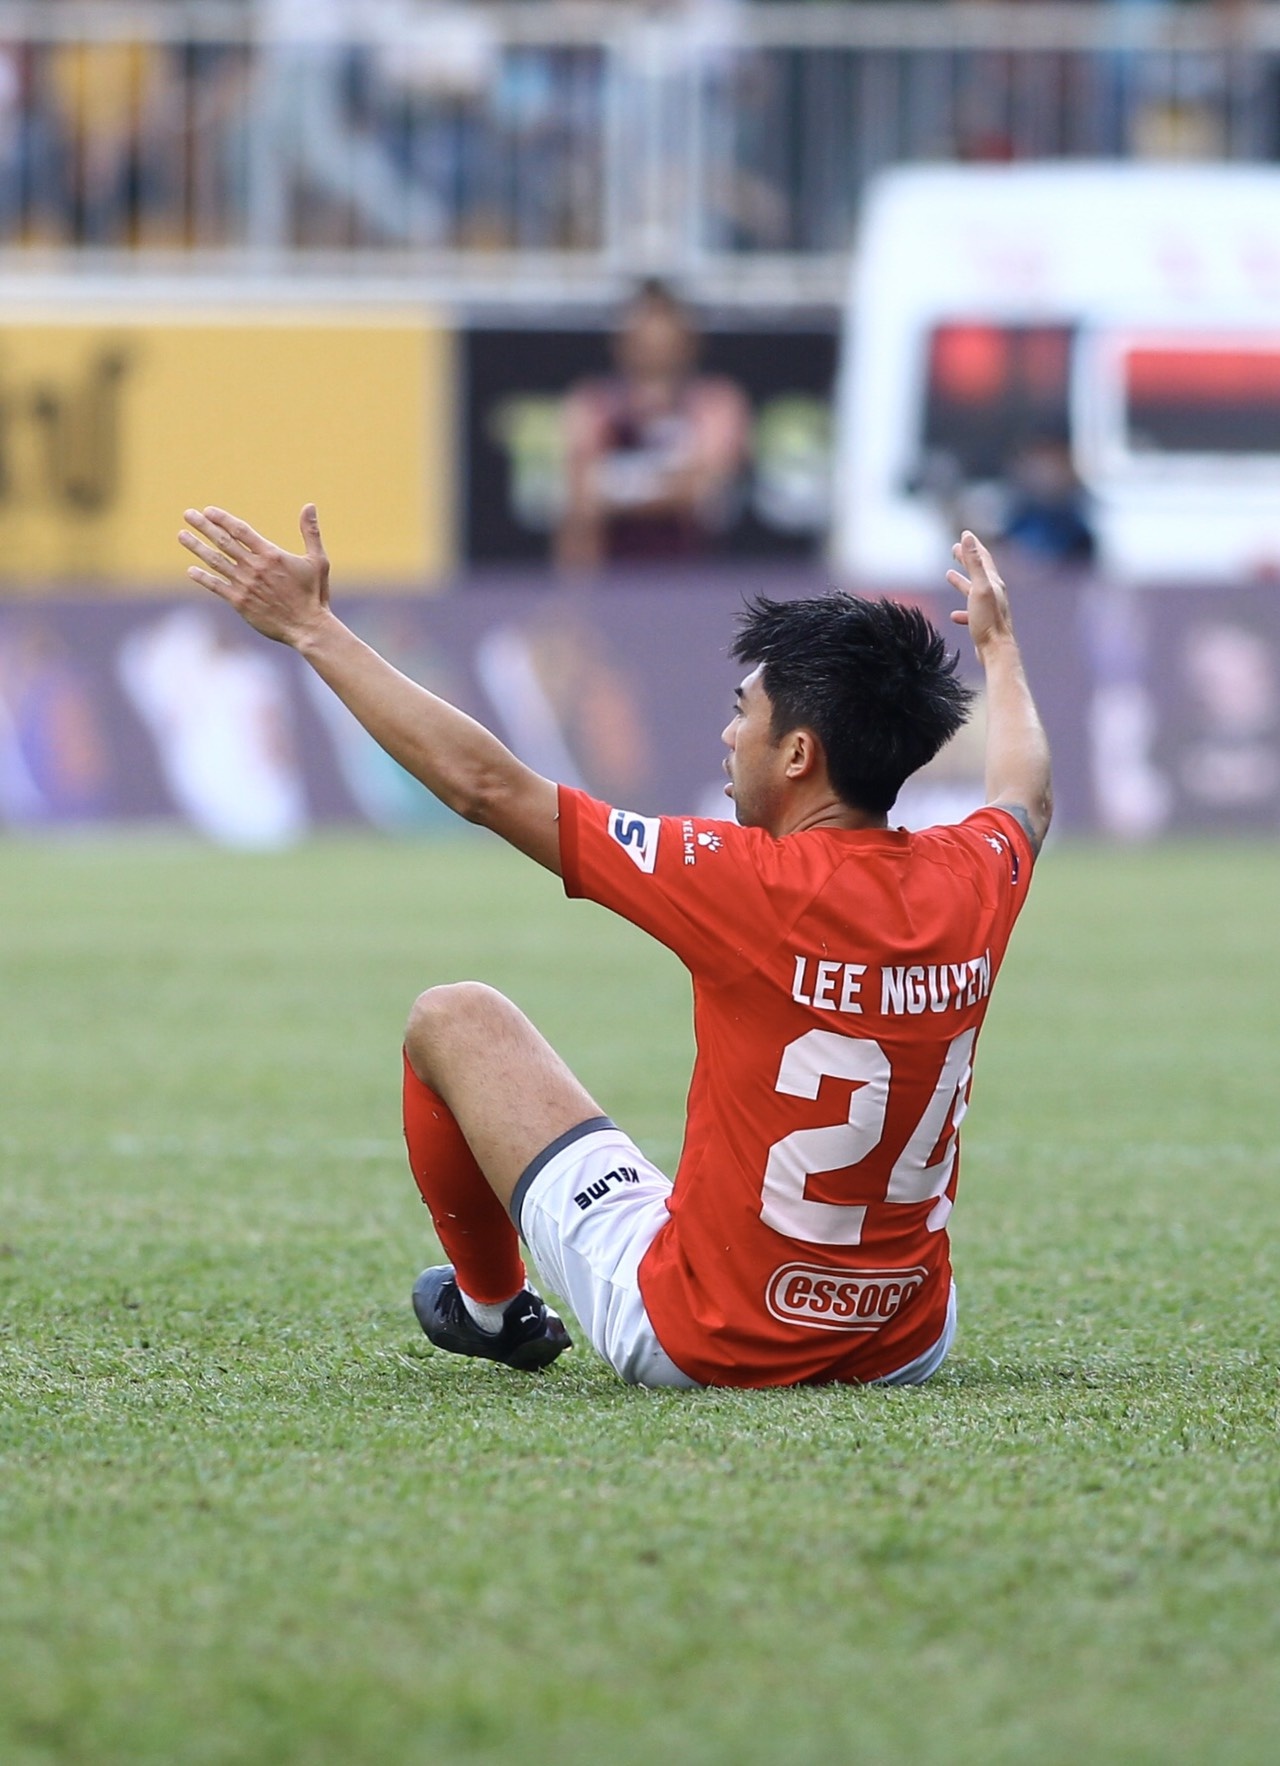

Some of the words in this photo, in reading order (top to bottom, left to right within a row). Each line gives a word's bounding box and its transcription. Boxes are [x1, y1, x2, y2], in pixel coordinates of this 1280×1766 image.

[791, 955, 868, 1014] LEE
[880, 948, 992, 1015] NGUYEN
[759, 1026, 977, 1246] 24
[573, 1166, 640, 1211] KELME
